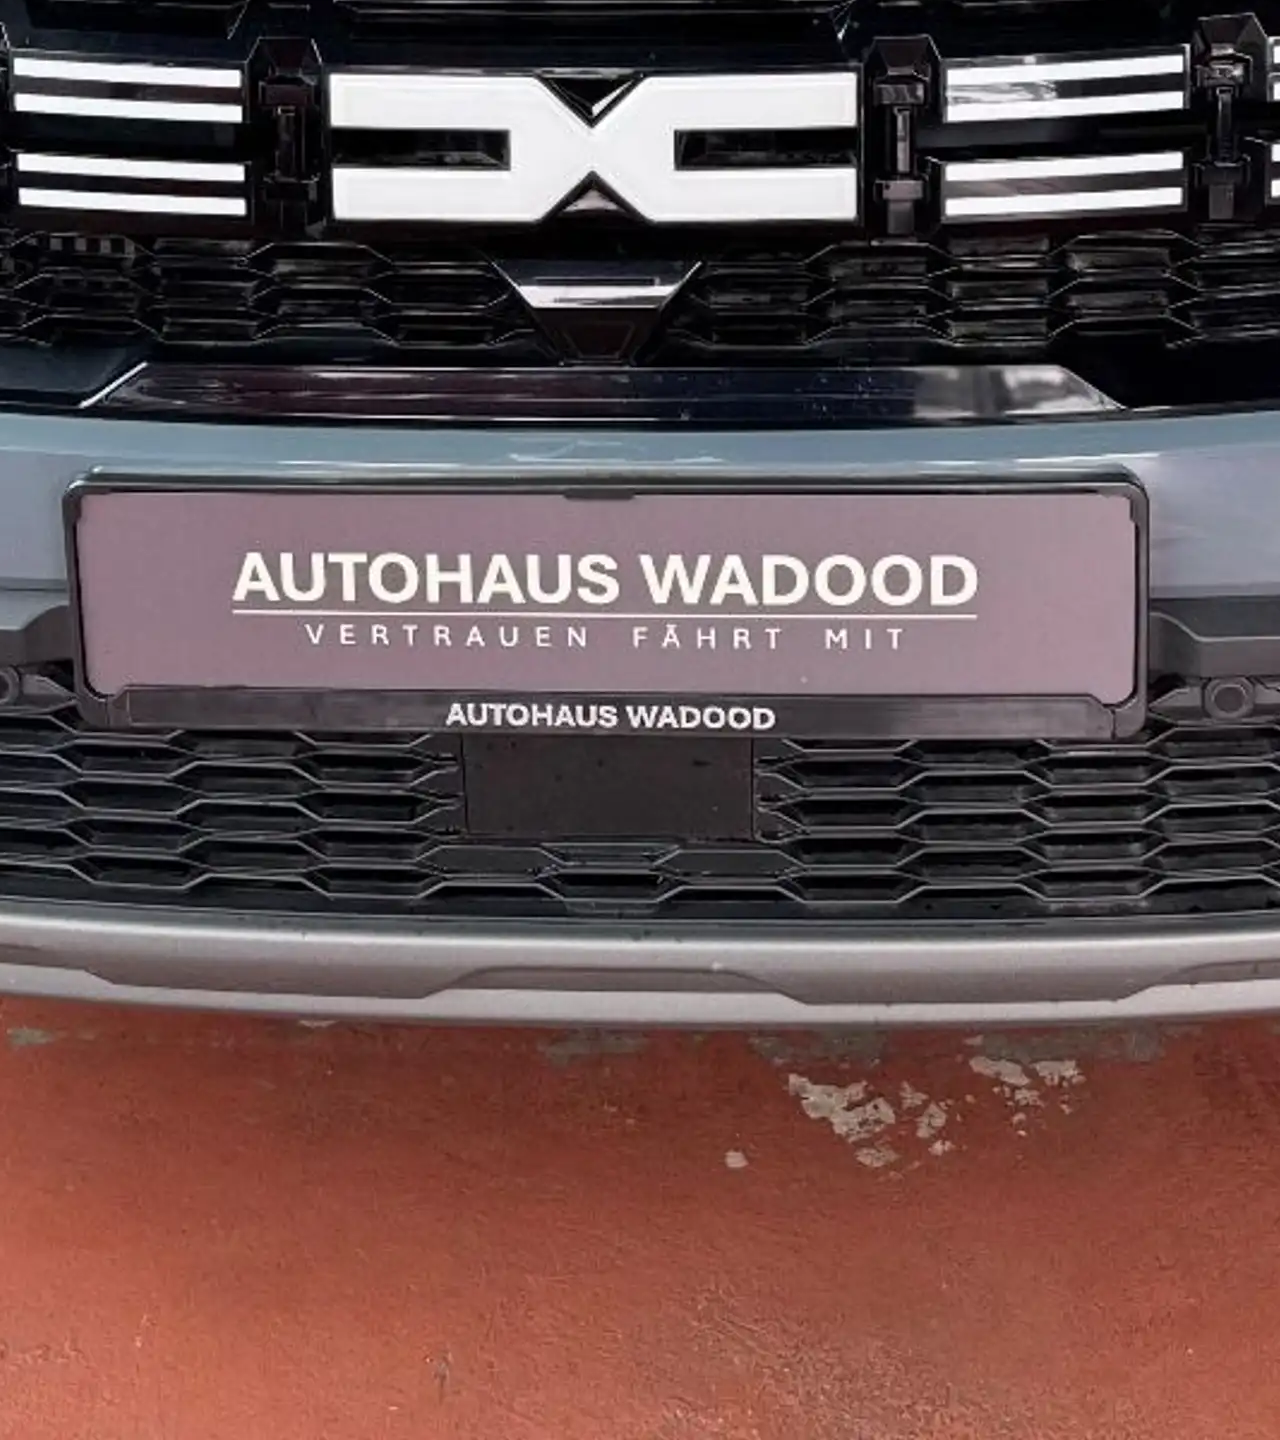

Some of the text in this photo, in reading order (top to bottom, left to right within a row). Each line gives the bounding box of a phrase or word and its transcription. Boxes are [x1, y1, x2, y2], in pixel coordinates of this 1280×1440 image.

[232, 551, 978, 607] AUTOHAUS WADOOD
[304, 622, 904, 651] VERTRAUEN FÄHRT MIT
[445, 701, 776, 731] AUTOHAUS WADOOD
